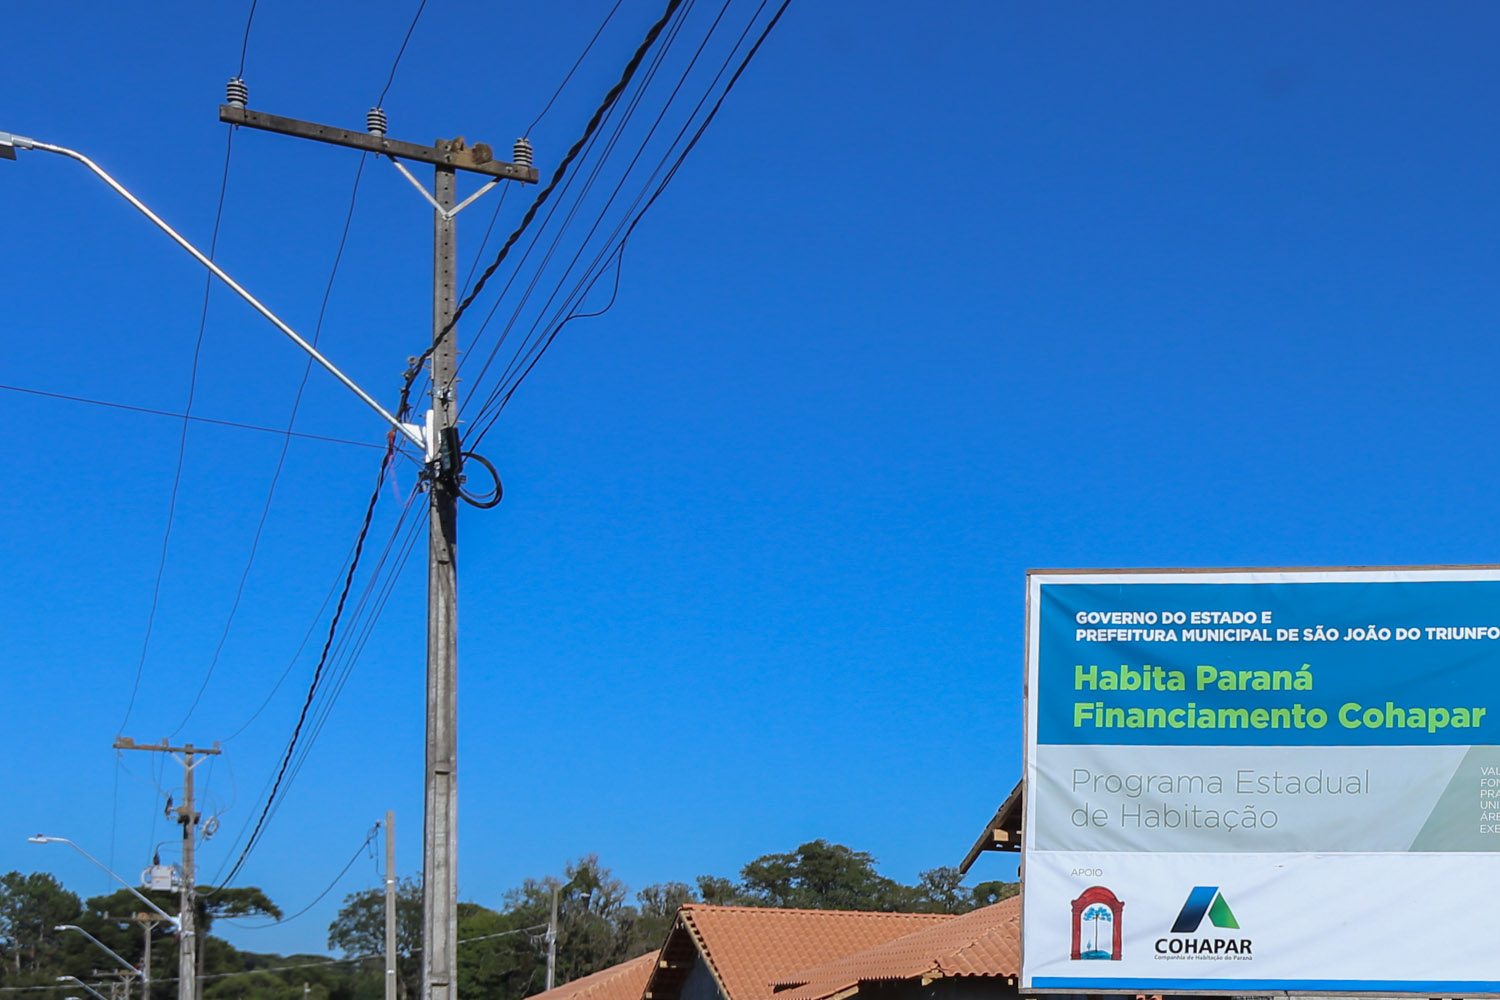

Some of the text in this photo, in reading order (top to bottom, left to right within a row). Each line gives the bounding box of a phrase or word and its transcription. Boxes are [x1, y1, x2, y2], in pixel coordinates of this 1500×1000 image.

[1075, 611, 1272, 624] GOVERNO DO ESTADO E
[1075, 625, 1500, 642] PREFEITURA MUNICIPAL DE SÃO JOÃO DO TRIUNFO
[1074, 663, 1313, 691] Habita Paraná
[1073, 702, 1487, 733] Financiamento Cohapar
[1072, 768, 1369, 798] Programa Estadual
[1071, 803, 1278, 832] de Habitação
[1070, 868, 1103, 877] APOIO
[1154, 938, 1253, 954] COHAPAR
